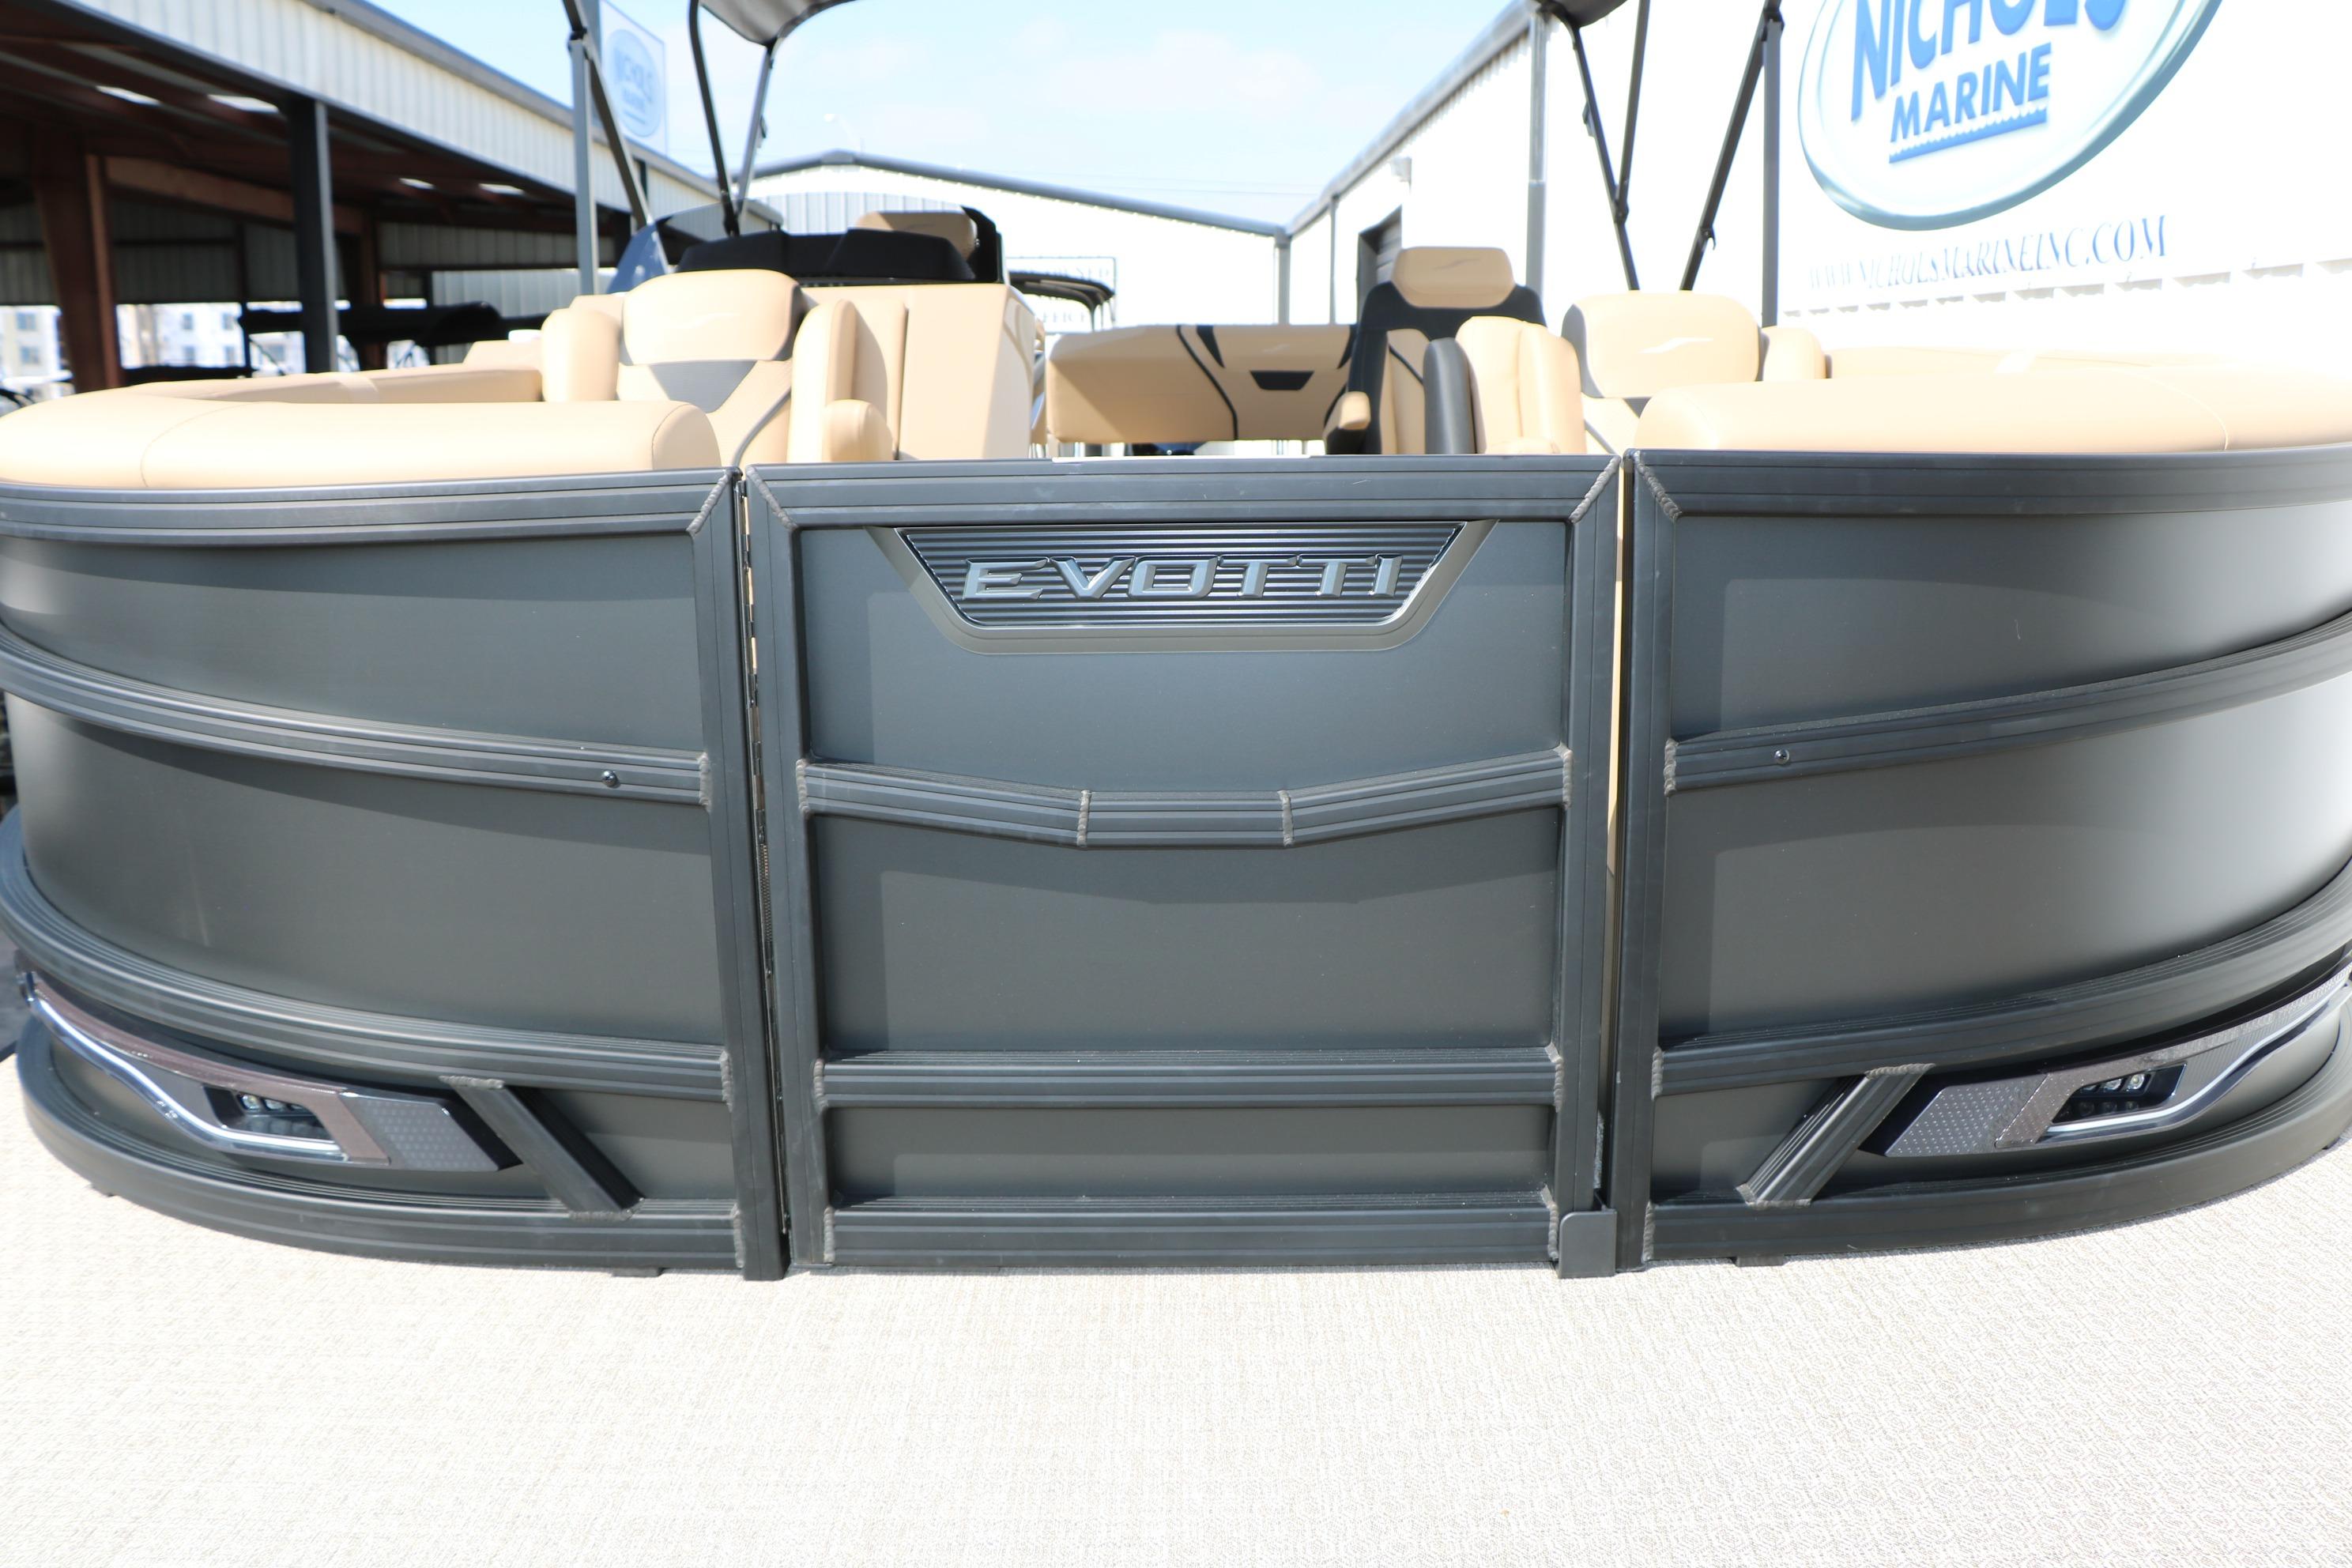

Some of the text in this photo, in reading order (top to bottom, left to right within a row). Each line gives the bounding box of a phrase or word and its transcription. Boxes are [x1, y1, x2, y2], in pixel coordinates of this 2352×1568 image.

[1851, 0, 2126, 122] NICH
[1890, 42, 2052, 143] MARINE
[1808, 215, 2166, 290] WWWNICHOLSMARINEINC.COM
[962, 555, 1404, 601] EVOTTI
